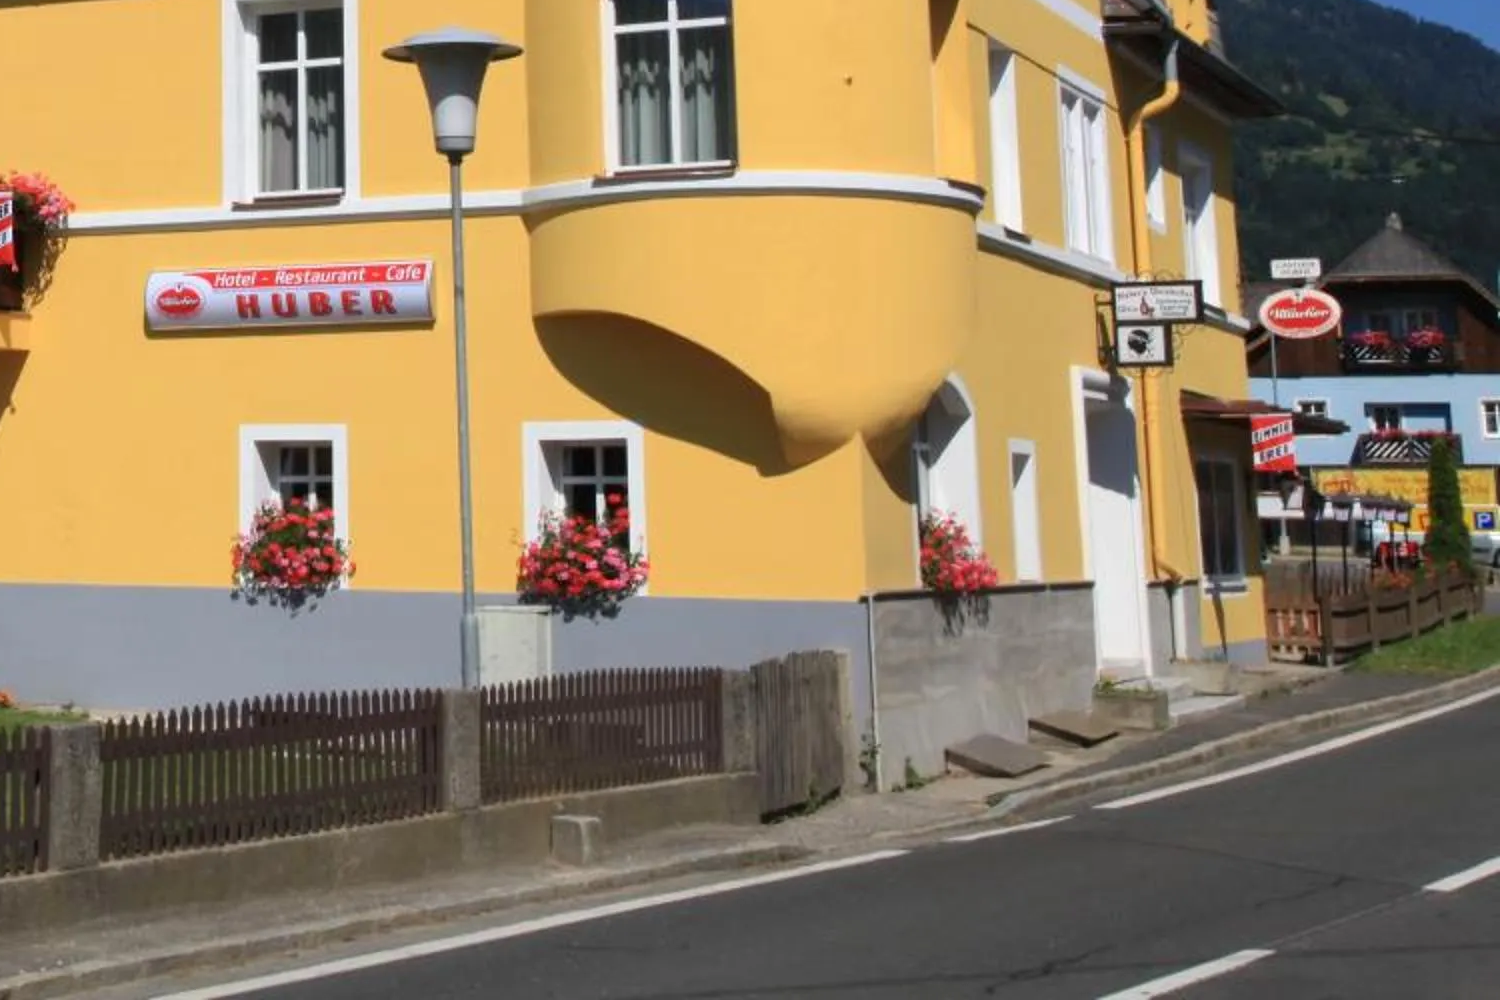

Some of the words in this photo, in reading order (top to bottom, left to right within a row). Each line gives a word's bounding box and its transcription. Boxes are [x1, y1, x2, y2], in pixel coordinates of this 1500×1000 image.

[213, 271, 257, 287] Hotel
[274, 267, 367, 285] Restaurant
[235, 289, 398, 319] HUBER
[1476, 513, 1492, 529] P
